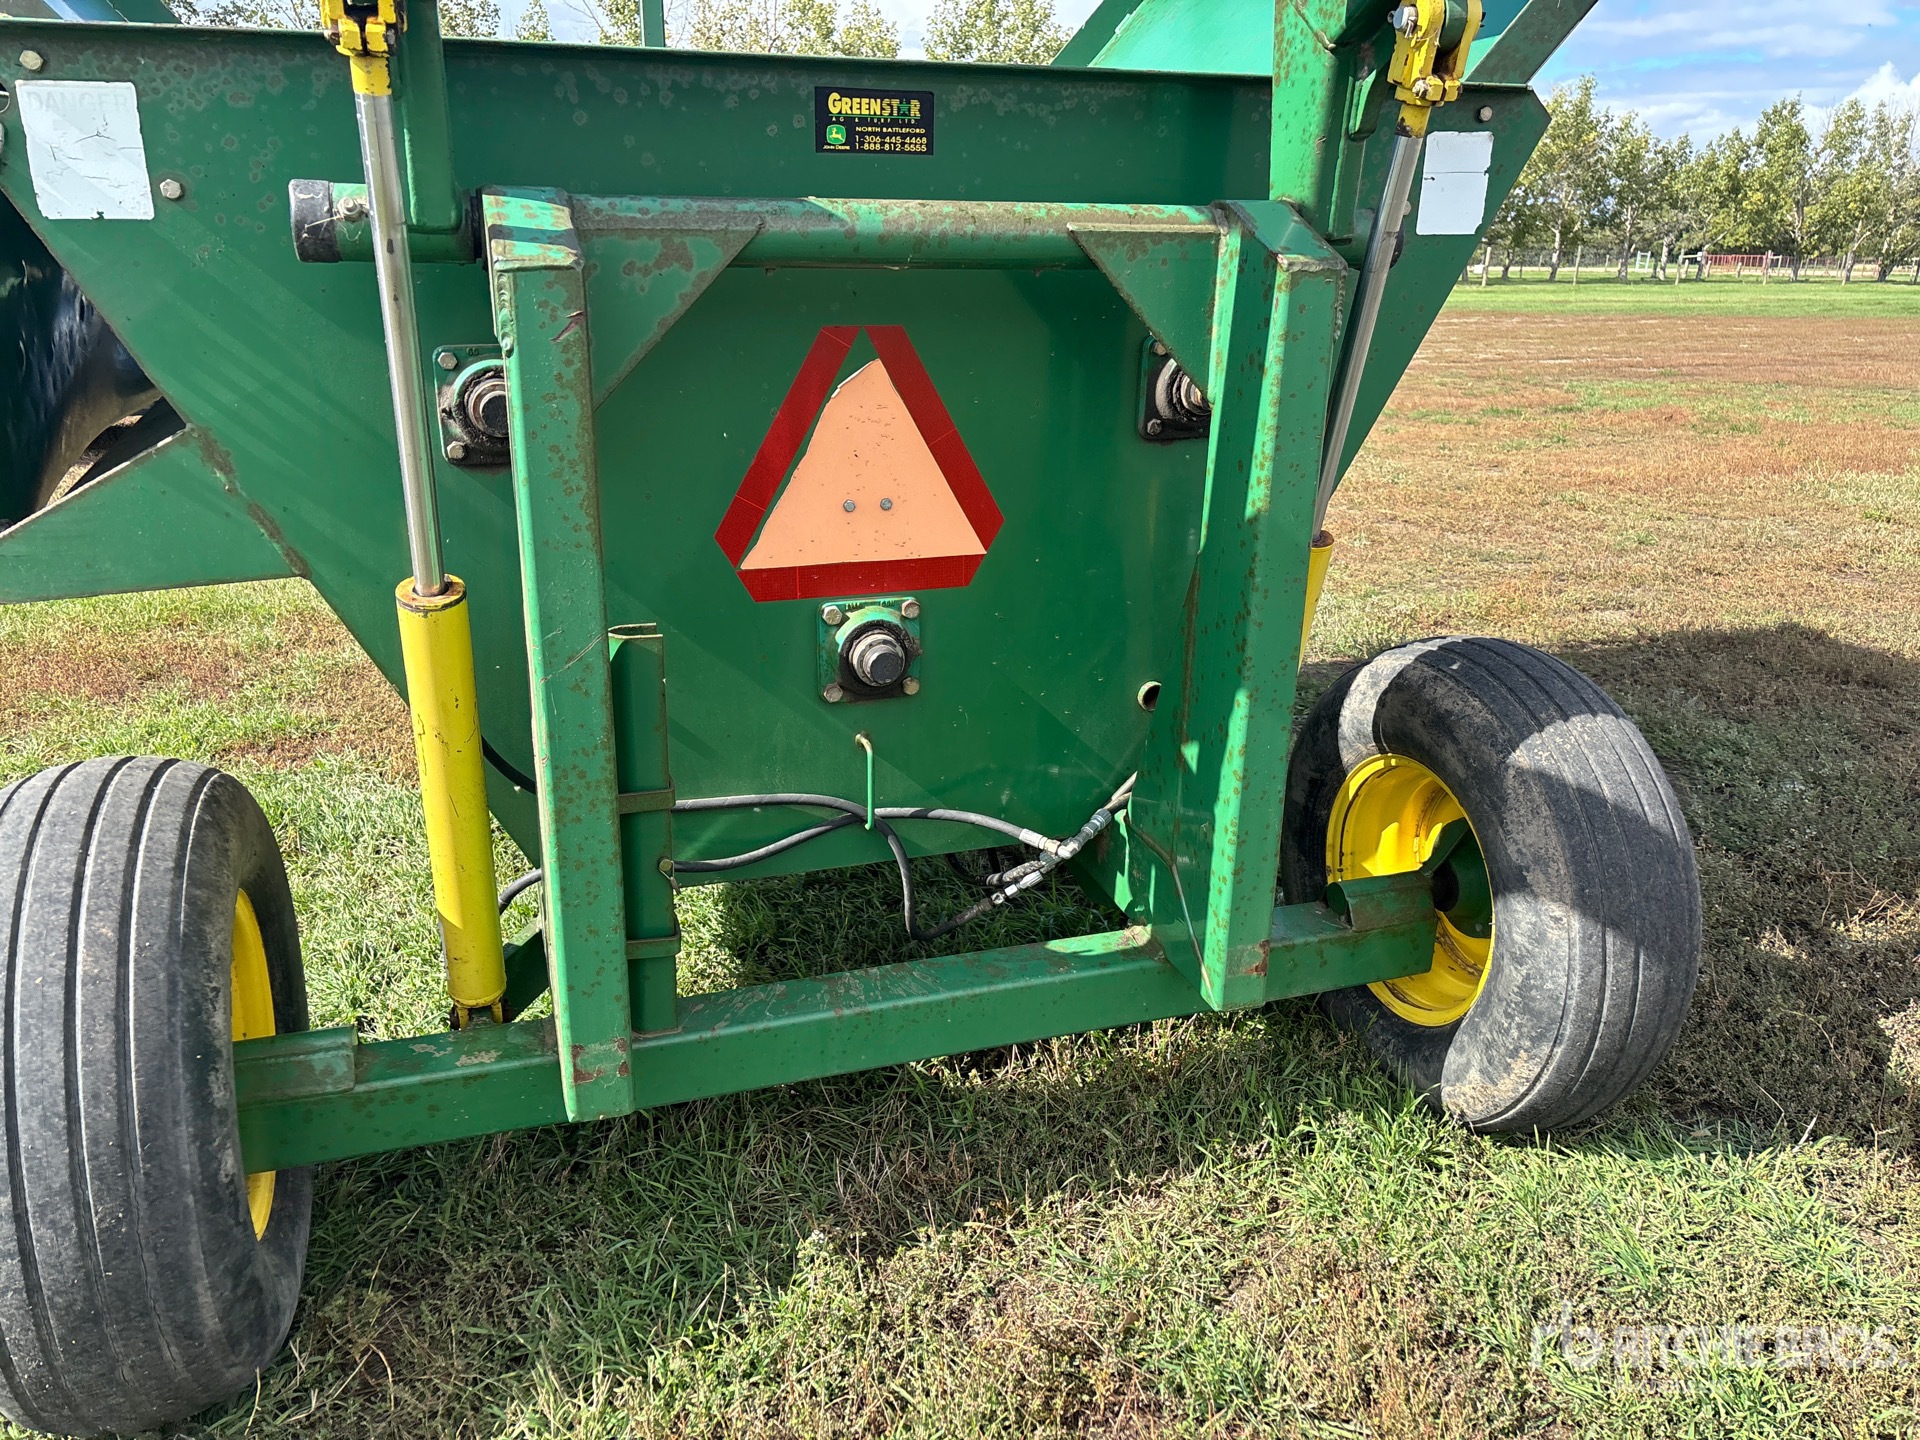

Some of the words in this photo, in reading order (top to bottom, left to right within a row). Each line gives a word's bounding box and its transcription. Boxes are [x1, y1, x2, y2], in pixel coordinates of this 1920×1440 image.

[26, 91, 129, 112] DANGER
[854, 135, 928, 144] 1-306-445-4468
[854, 143, 928, 152] 1-888-812-5555
